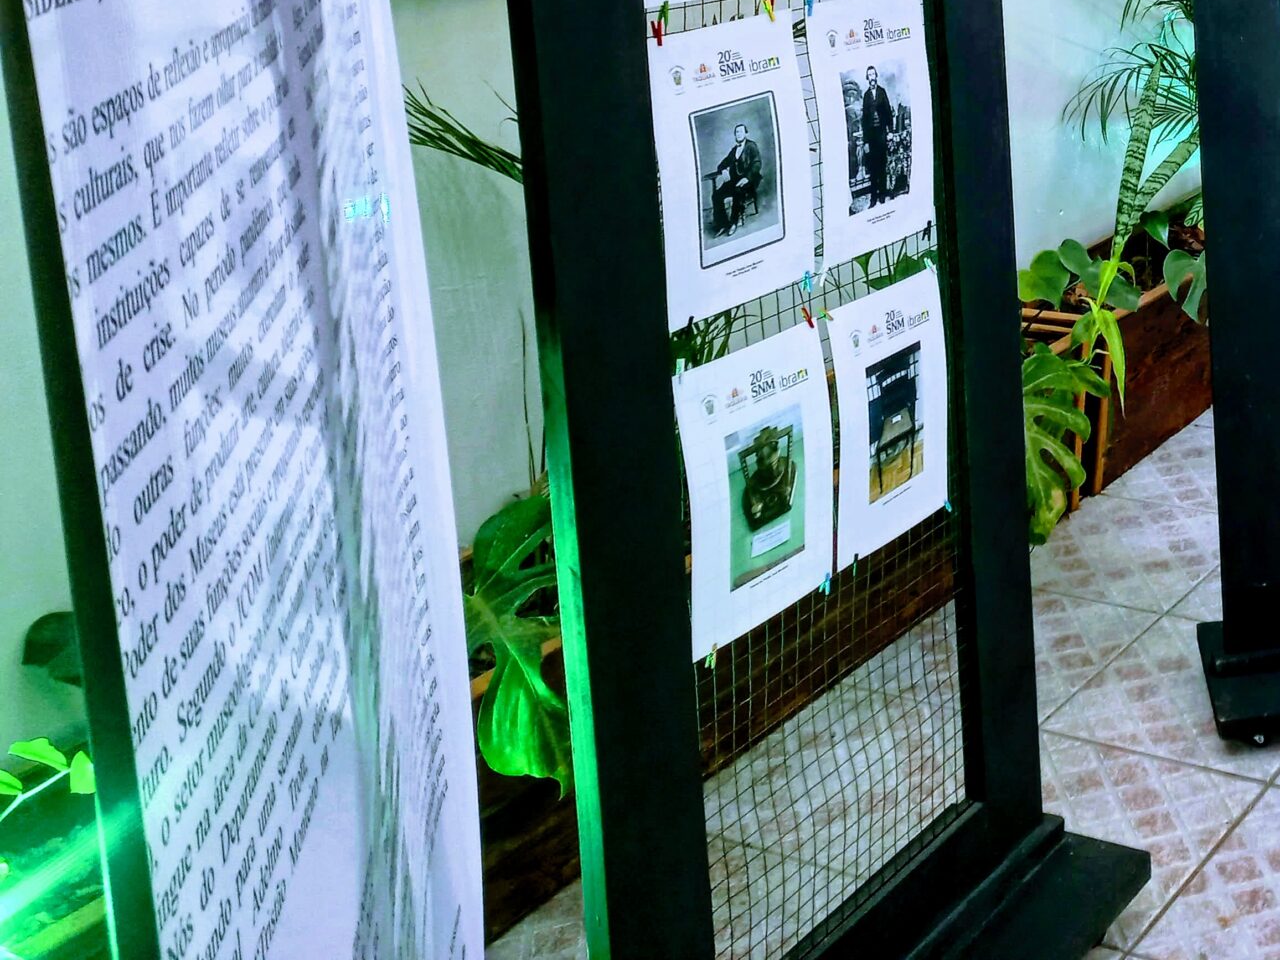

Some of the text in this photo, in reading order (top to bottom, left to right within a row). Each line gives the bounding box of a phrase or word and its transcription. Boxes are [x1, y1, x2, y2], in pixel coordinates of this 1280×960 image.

[719, 60, 745, 77] SNM
[749, 57, 780, 72] ibram
[864, 28, 884, 42] SNM
[887, 27, 910, 39] ibram
[62, 108, 88, 155] são
[91, 81, 144, 139] espaços
[147, 62, 162, 101] de
[163, 40, 201, 90] reflexão
[143, 132, 165, 178] que
[169, 115, 186, 149] nos
[188, 93, 214, 132] fazem
[86, 214, 147, 284] mesmos.
[150, 179, 162, 229] É
[164, 150, 213, 216] importante
[95, 257, 171, 351] instituições
[179, 211, 215, 268] capazes
[219, 187, 231, 222] de
[908, 311, 929, 326] ibram
[115, 357, 132, 402] de
[143, 322, 176, 374] crise.
[181, 285, 199, 329] No
[205, 243, 236, 313] período
[886, 317, 904, 334] SNM
[169, 349, 204, 413] muitos
[751, 378, 775, 398] SNM
[779, 369, 808, 388] ibram
[133, 455, 174, 526] outras
[138, 561, 147, 590] o
[151, 504, 187, 584] poder
[190, 476, 203, 516] de
[164, 572, 186, 624] dos
[189, 503, 227, 584] Museus
[162, 655, 178, 700] de
[179, 610, 205, 670] suas
[206, 543, 242, 622] funções
[177, 639, 226, 743] Segundo
[228, 621, 236, 647] o
[236, 552, 264, 628] ICOM
[160, 816, 171, 847] o
[173, 748, 205, 823] setor
[195, 808, 211, 852] na
[213, 754, 236, 815] área
[235, 722, 248, 769] da
[200, 865, 215, 913] do
[219, 710, 278, 865] Departamento
[235, 837, 257, 908] para
[257, 782, 276, 837] uma
[252, 826, 283, 926] Adelmo
